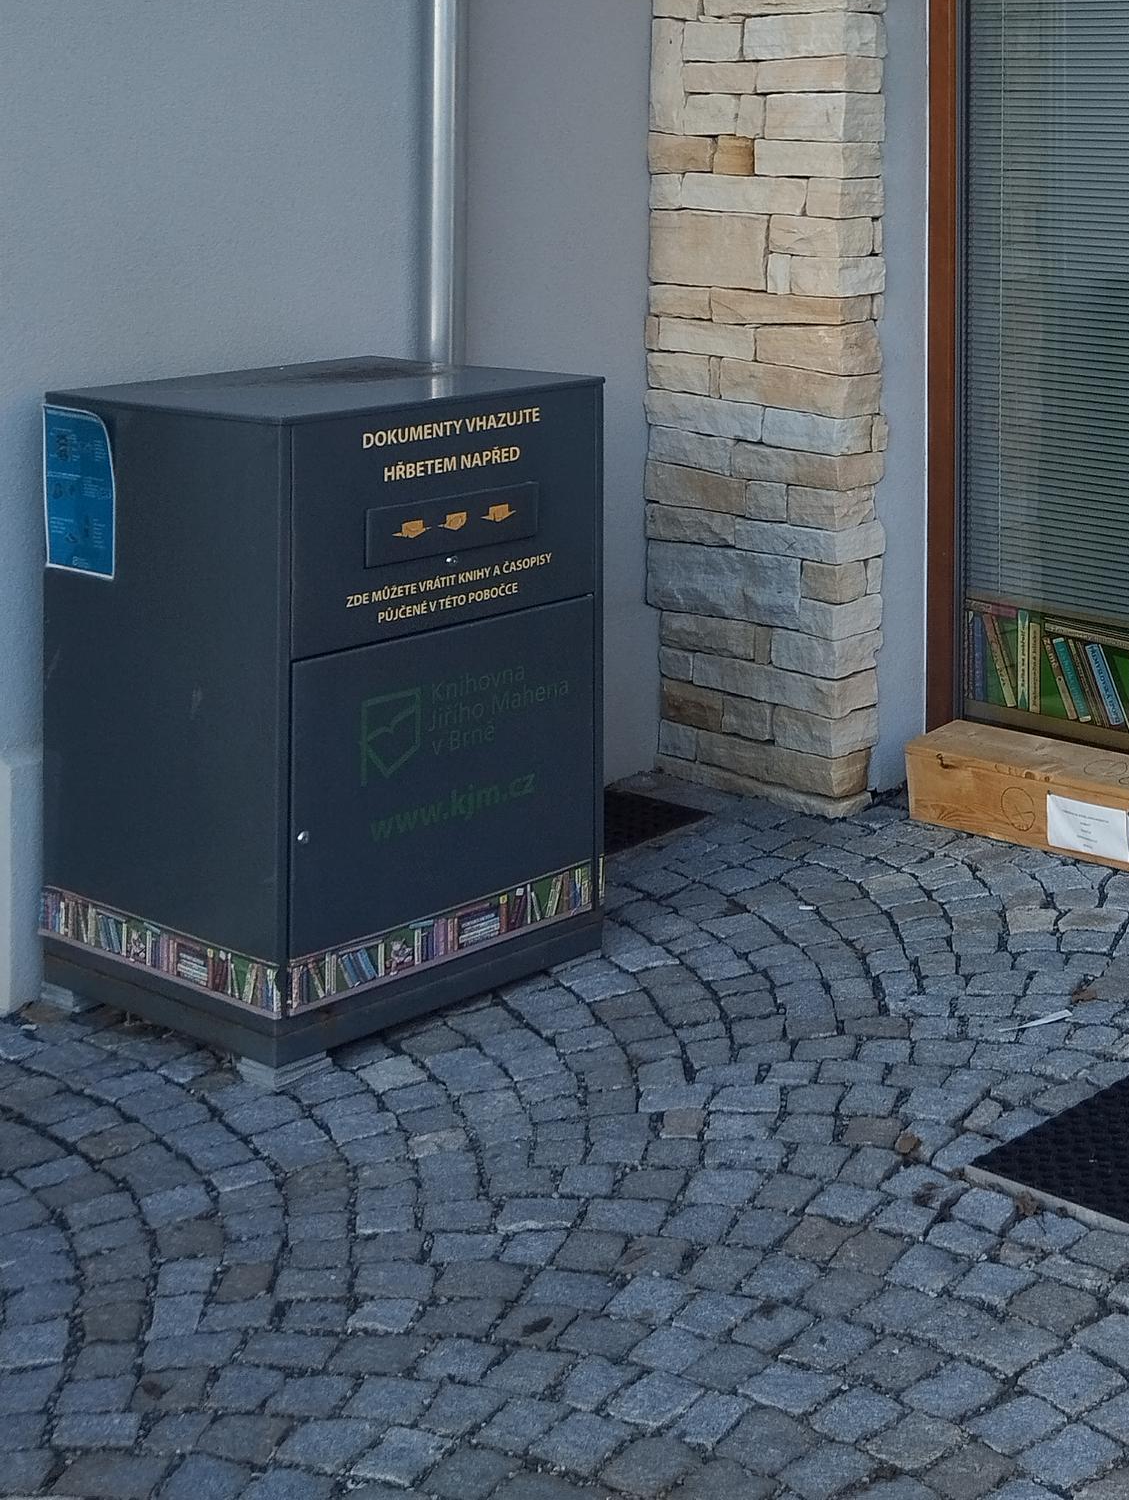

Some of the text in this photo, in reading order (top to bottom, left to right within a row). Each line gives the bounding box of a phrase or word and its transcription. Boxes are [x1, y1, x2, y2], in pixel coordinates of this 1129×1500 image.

[362, 407, 541, 449] DOKUMENTY VHAZUJTE
[383, 446, 521, 482] HŘBETEM NAPŘED
[346, 552, 553, 608] ZDE MŮŽETE VRÁTIT KNIHY A ČASOPISY
[377, 582, 519, 623] PŮJČENÉ V TÉTO POBOČCE
[431, 665, 526, 704] Knihovna
[428, 679, 570, 732] Jiřího Mahena
[432, 722, 496, 756] v Brně
[369, 772, 536, 842] www.kjm.cz
